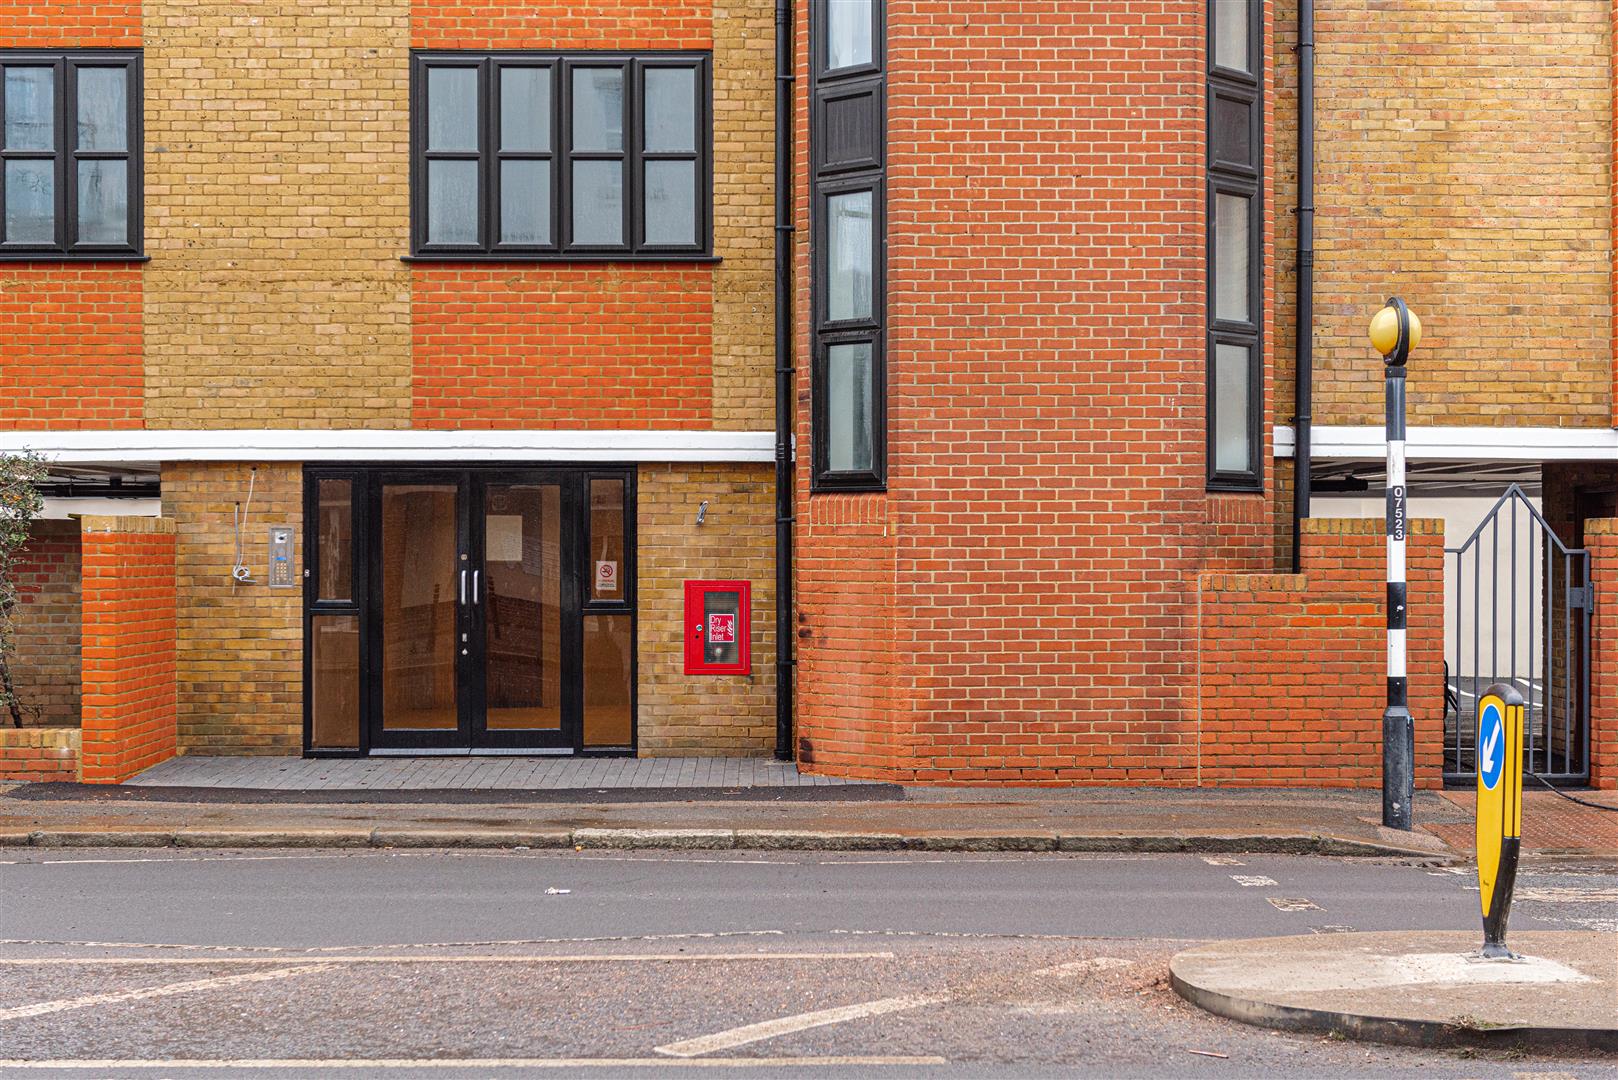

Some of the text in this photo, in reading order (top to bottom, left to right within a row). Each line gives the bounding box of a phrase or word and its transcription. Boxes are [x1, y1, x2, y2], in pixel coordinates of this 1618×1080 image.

[1394, 487, 1403, 540] 07523
[710, 616, 721, 625] Dry
[710, 624, 727, 632] Riser
[710, 633, 724, 641] Inlet
